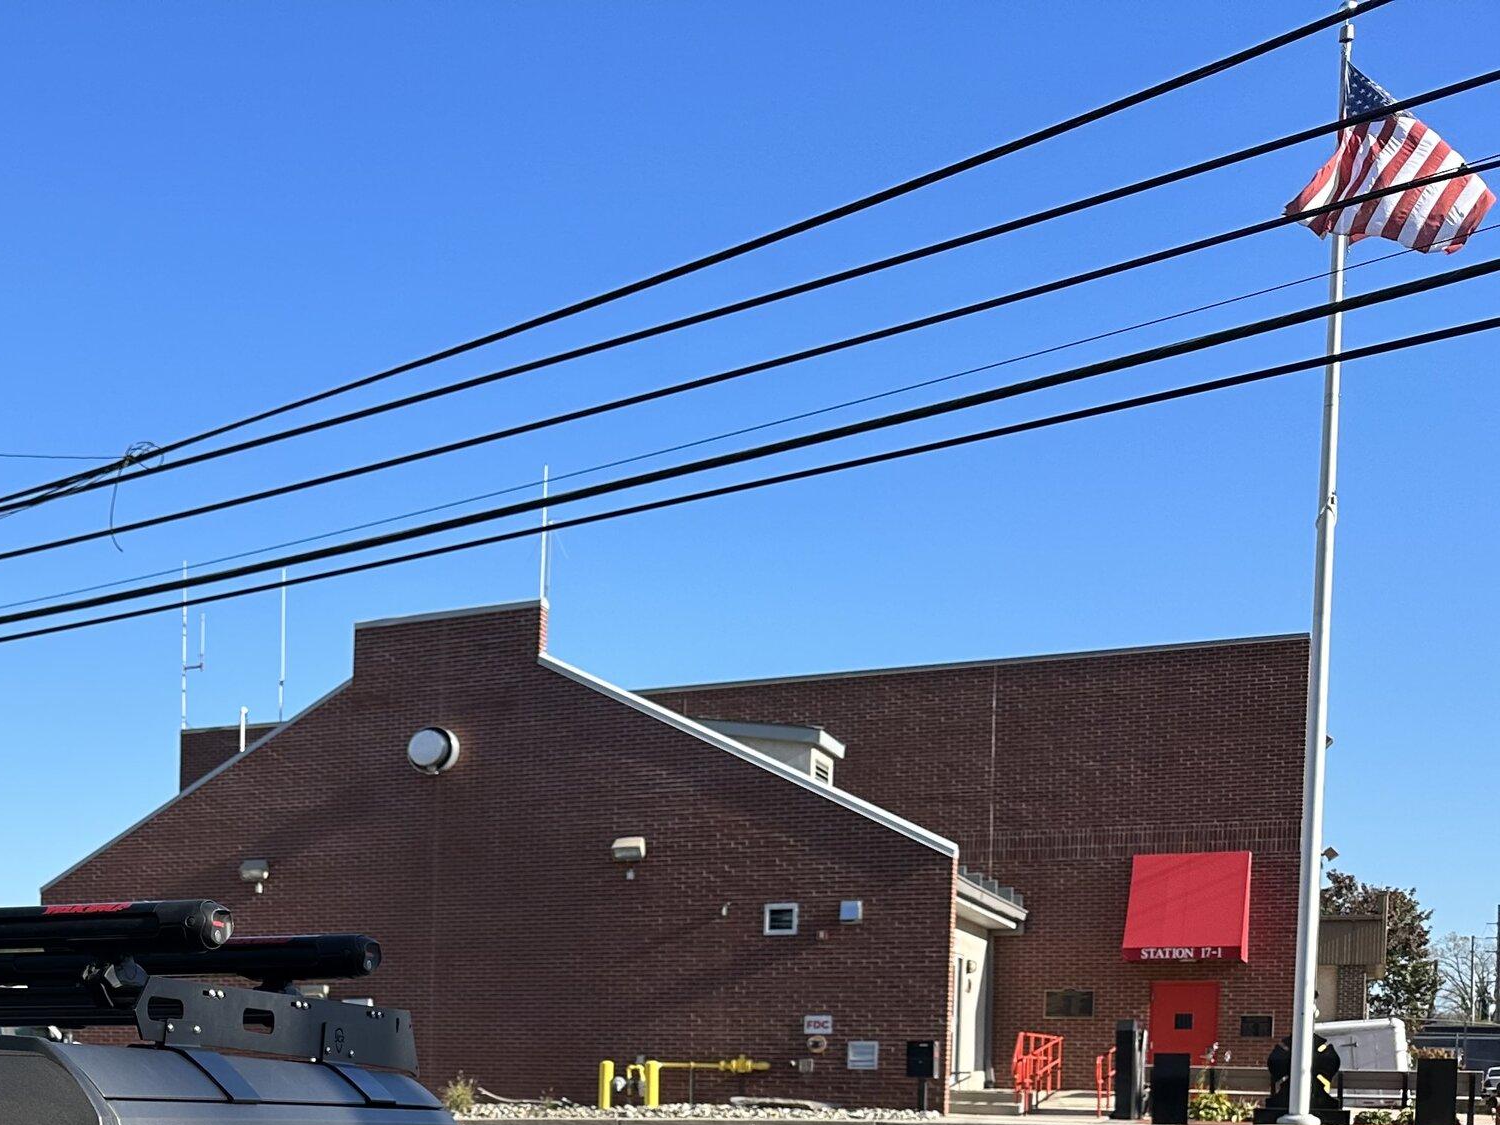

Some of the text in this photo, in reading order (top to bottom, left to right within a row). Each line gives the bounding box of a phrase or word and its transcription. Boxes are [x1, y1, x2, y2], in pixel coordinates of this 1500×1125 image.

[1140, 947, 1222, 959] STATION 17-1
[806, 1020, 830, 1029] FDC
